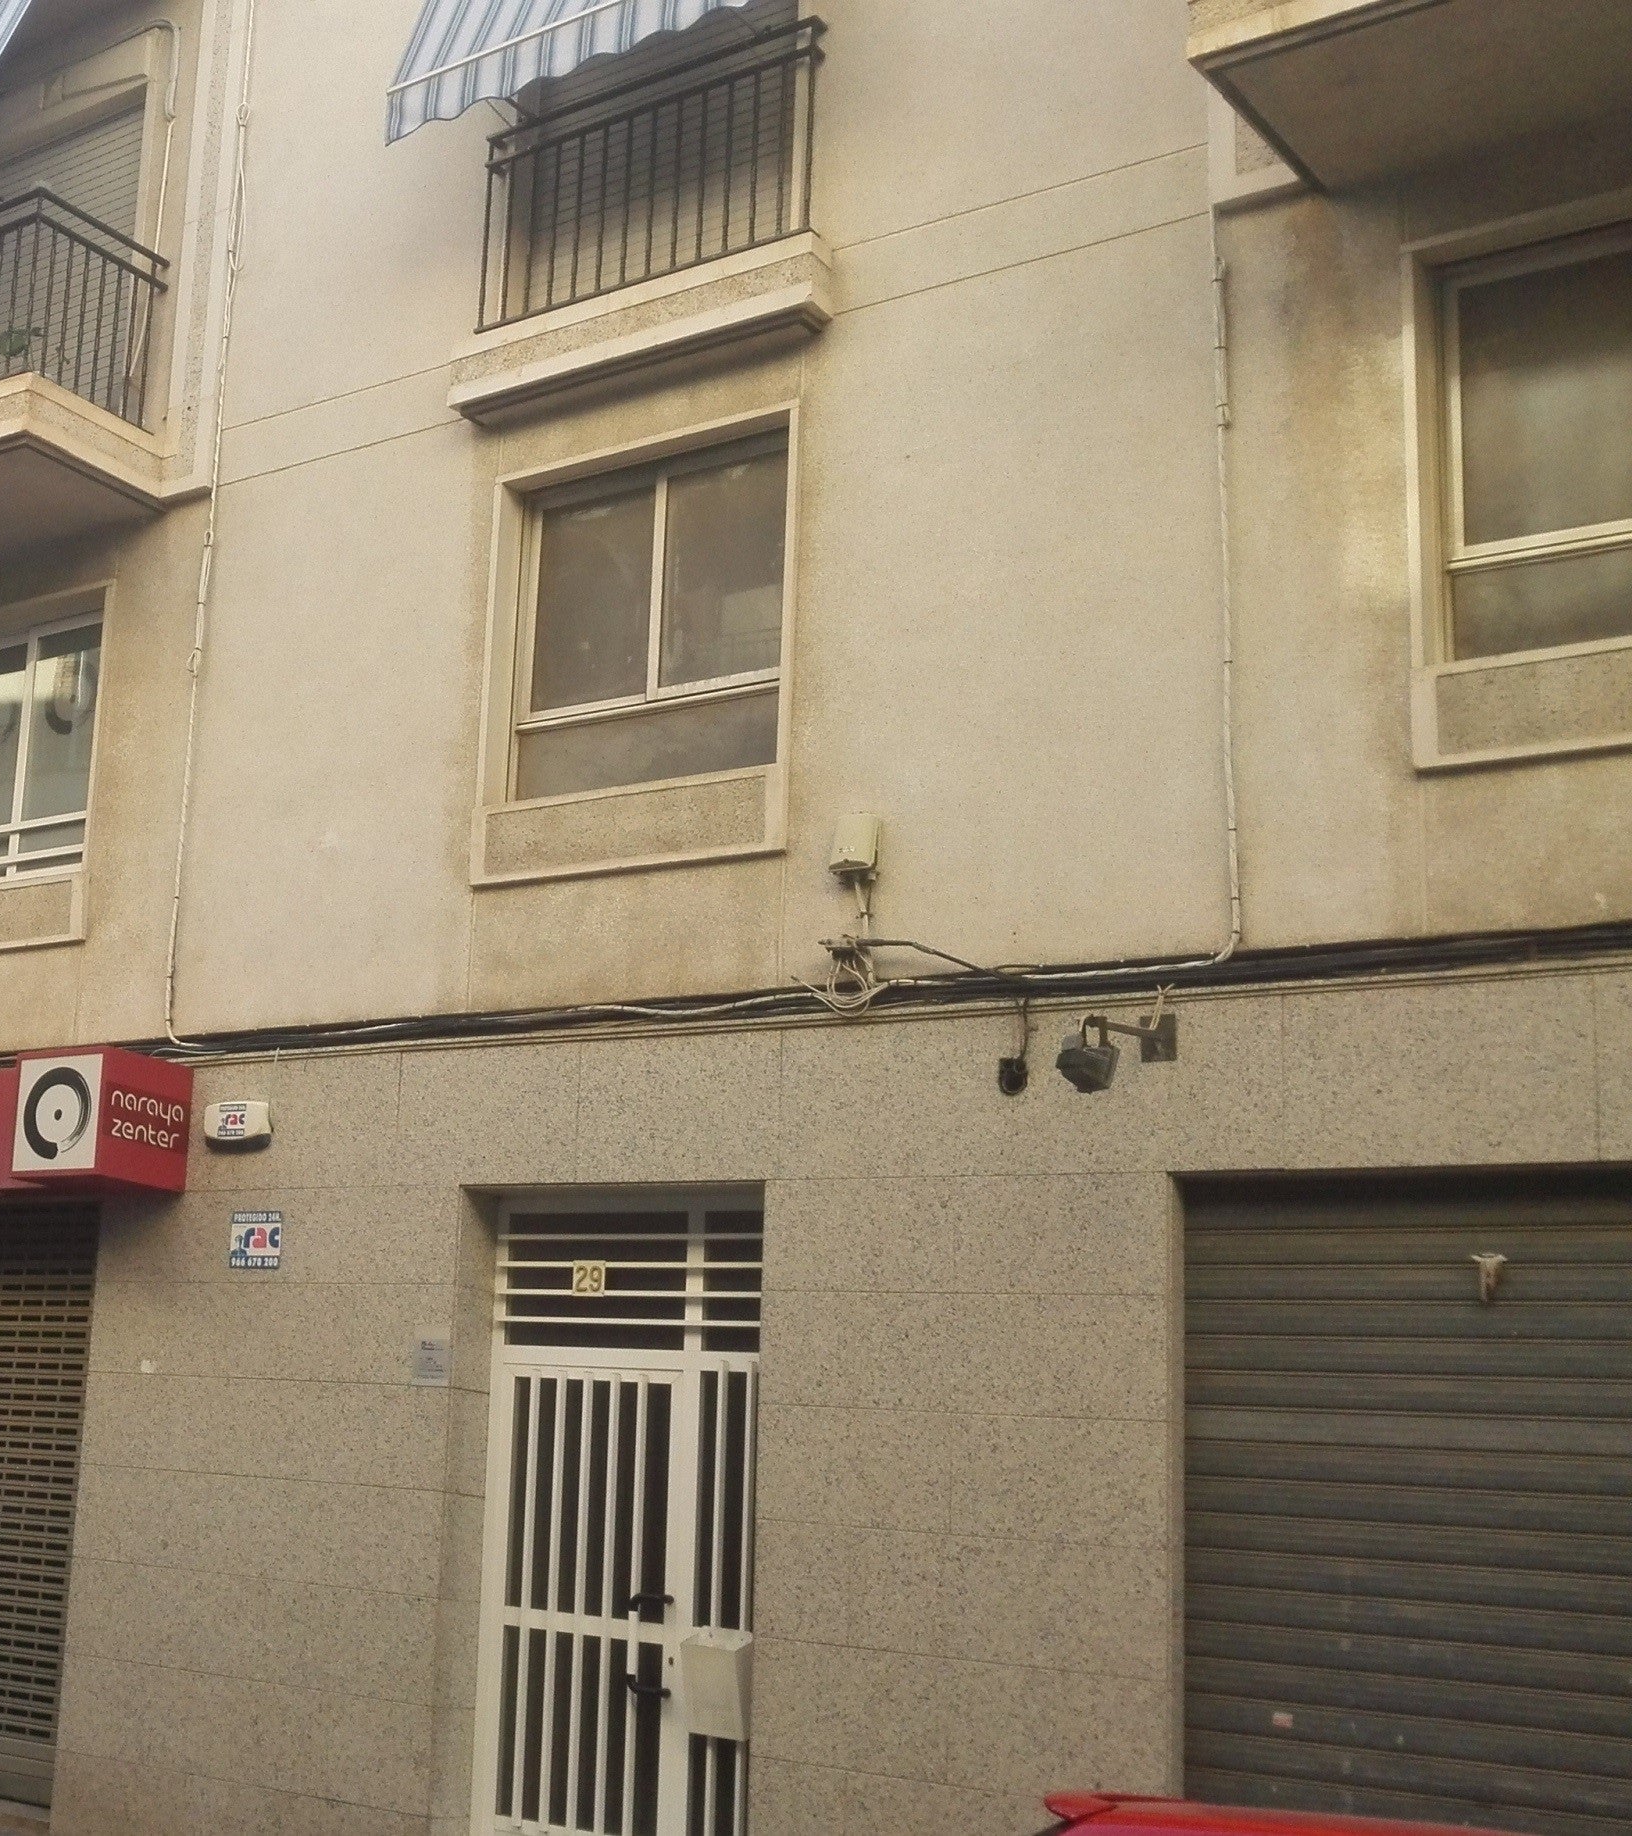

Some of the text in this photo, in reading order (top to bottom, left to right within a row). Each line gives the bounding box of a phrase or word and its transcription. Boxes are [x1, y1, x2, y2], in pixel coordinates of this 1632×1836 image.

[111, 1090, 184, 1126] naraya
[225, 1113, 246, 1126] rac
[111, 1118, 180, 1149] zenter
[233, 1212, 268, 1223] PROTEGIDO
[243, 1226, 280, 1249] rac
[231, 1256, 246, 1267] 966
[263, 1256, 279, 1267] 200
[575, 1264, 603, 1293] 29
